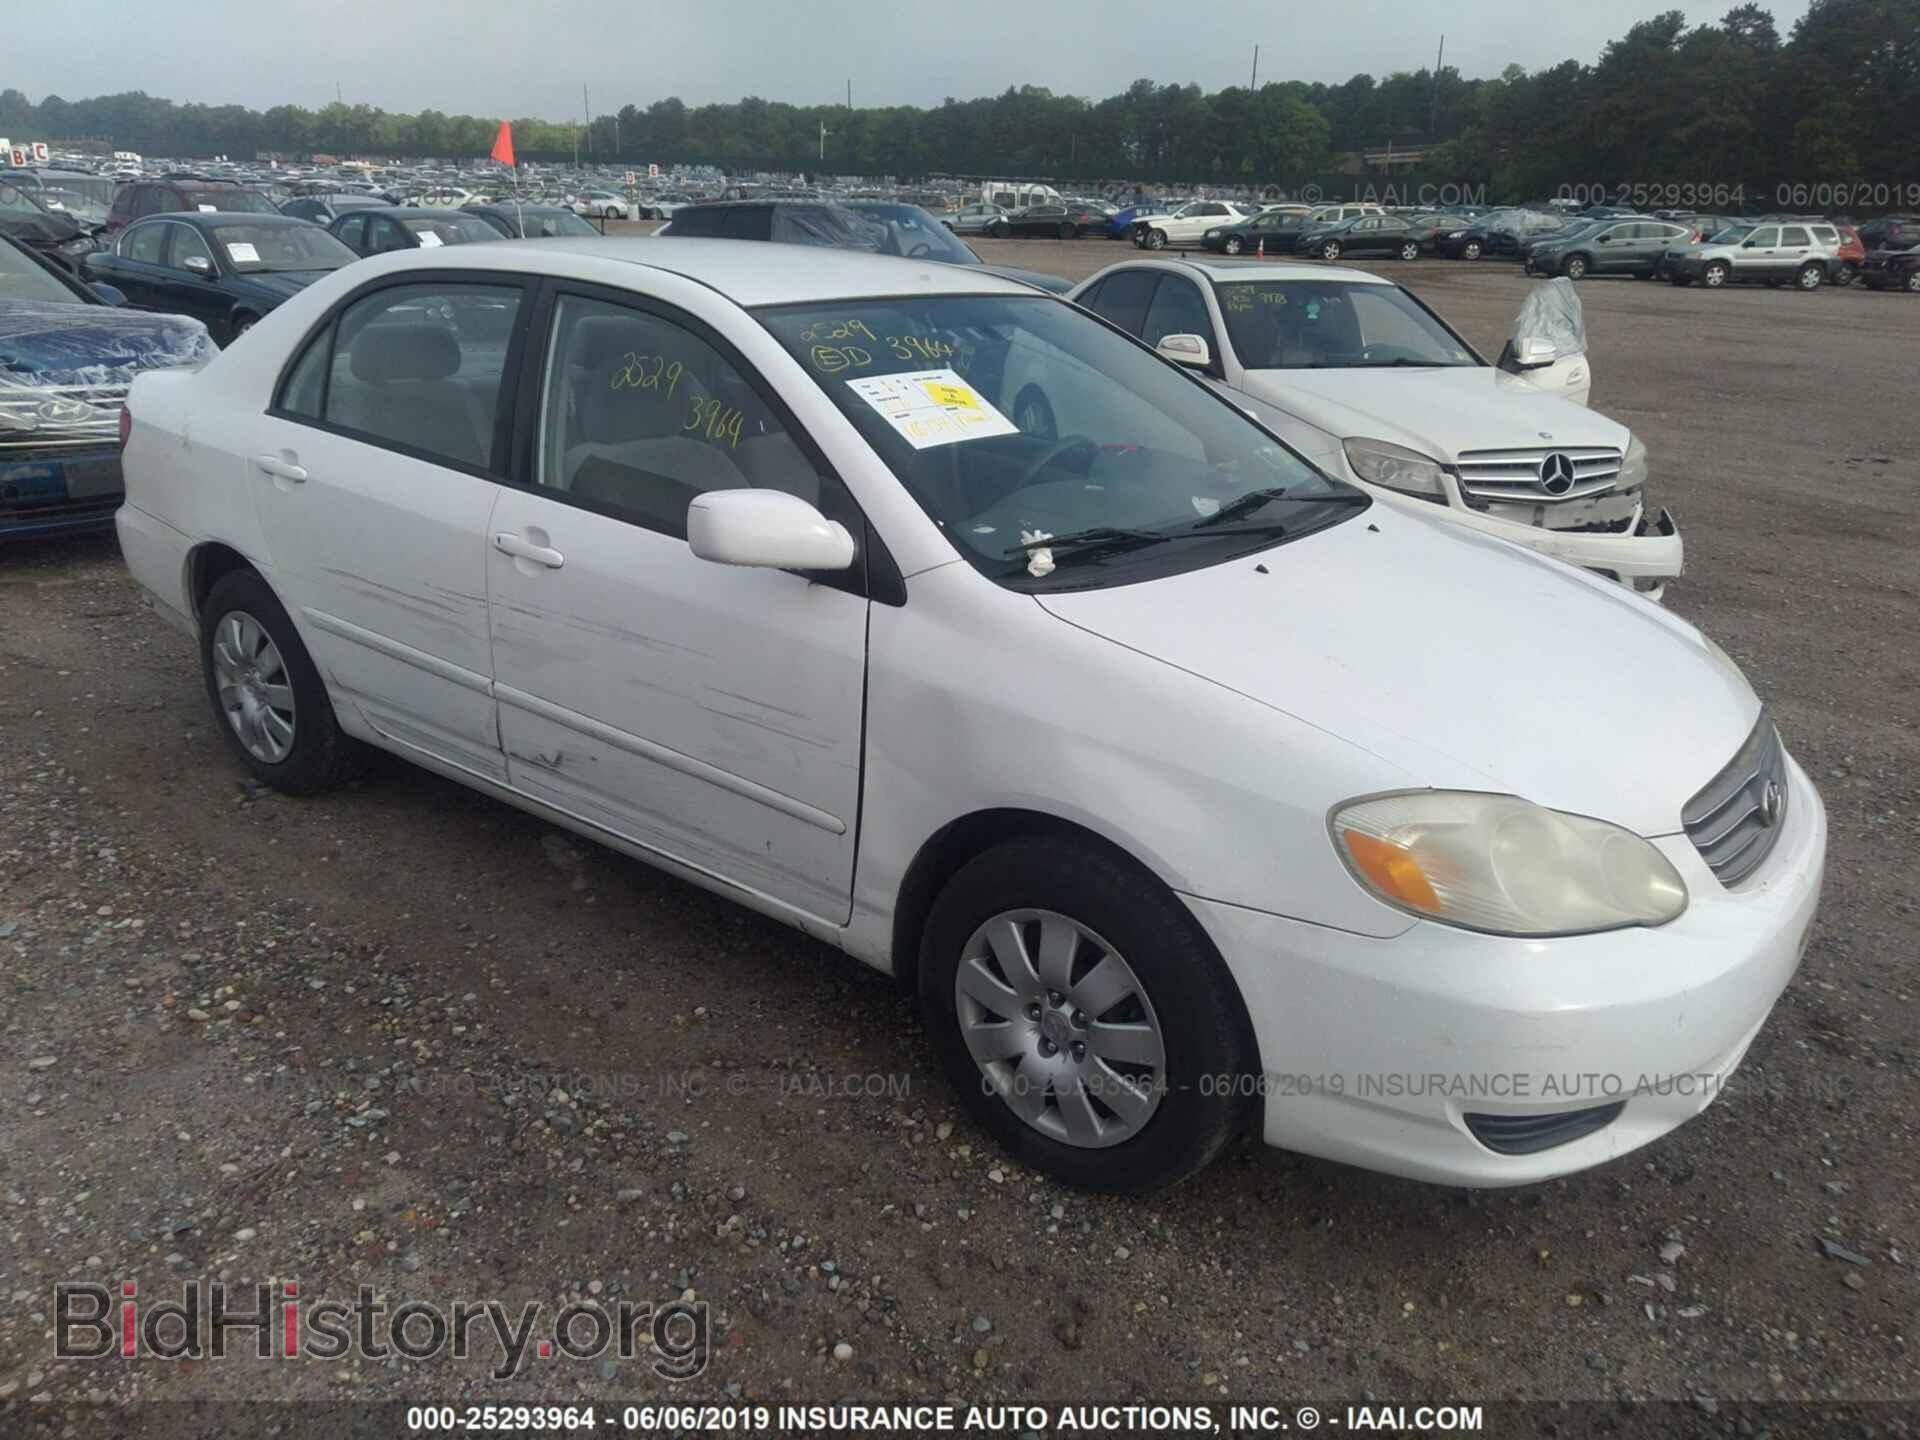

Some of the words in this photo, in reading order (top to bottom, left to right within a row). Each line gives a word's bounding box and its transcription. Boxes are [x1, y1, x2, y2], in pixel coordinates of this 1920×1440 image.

[12, 150, 24, 165] B
[36, 144, 47, 159] C
[611, 352, 683, 400] 2529
[684, 396, 744, 448] 3964
